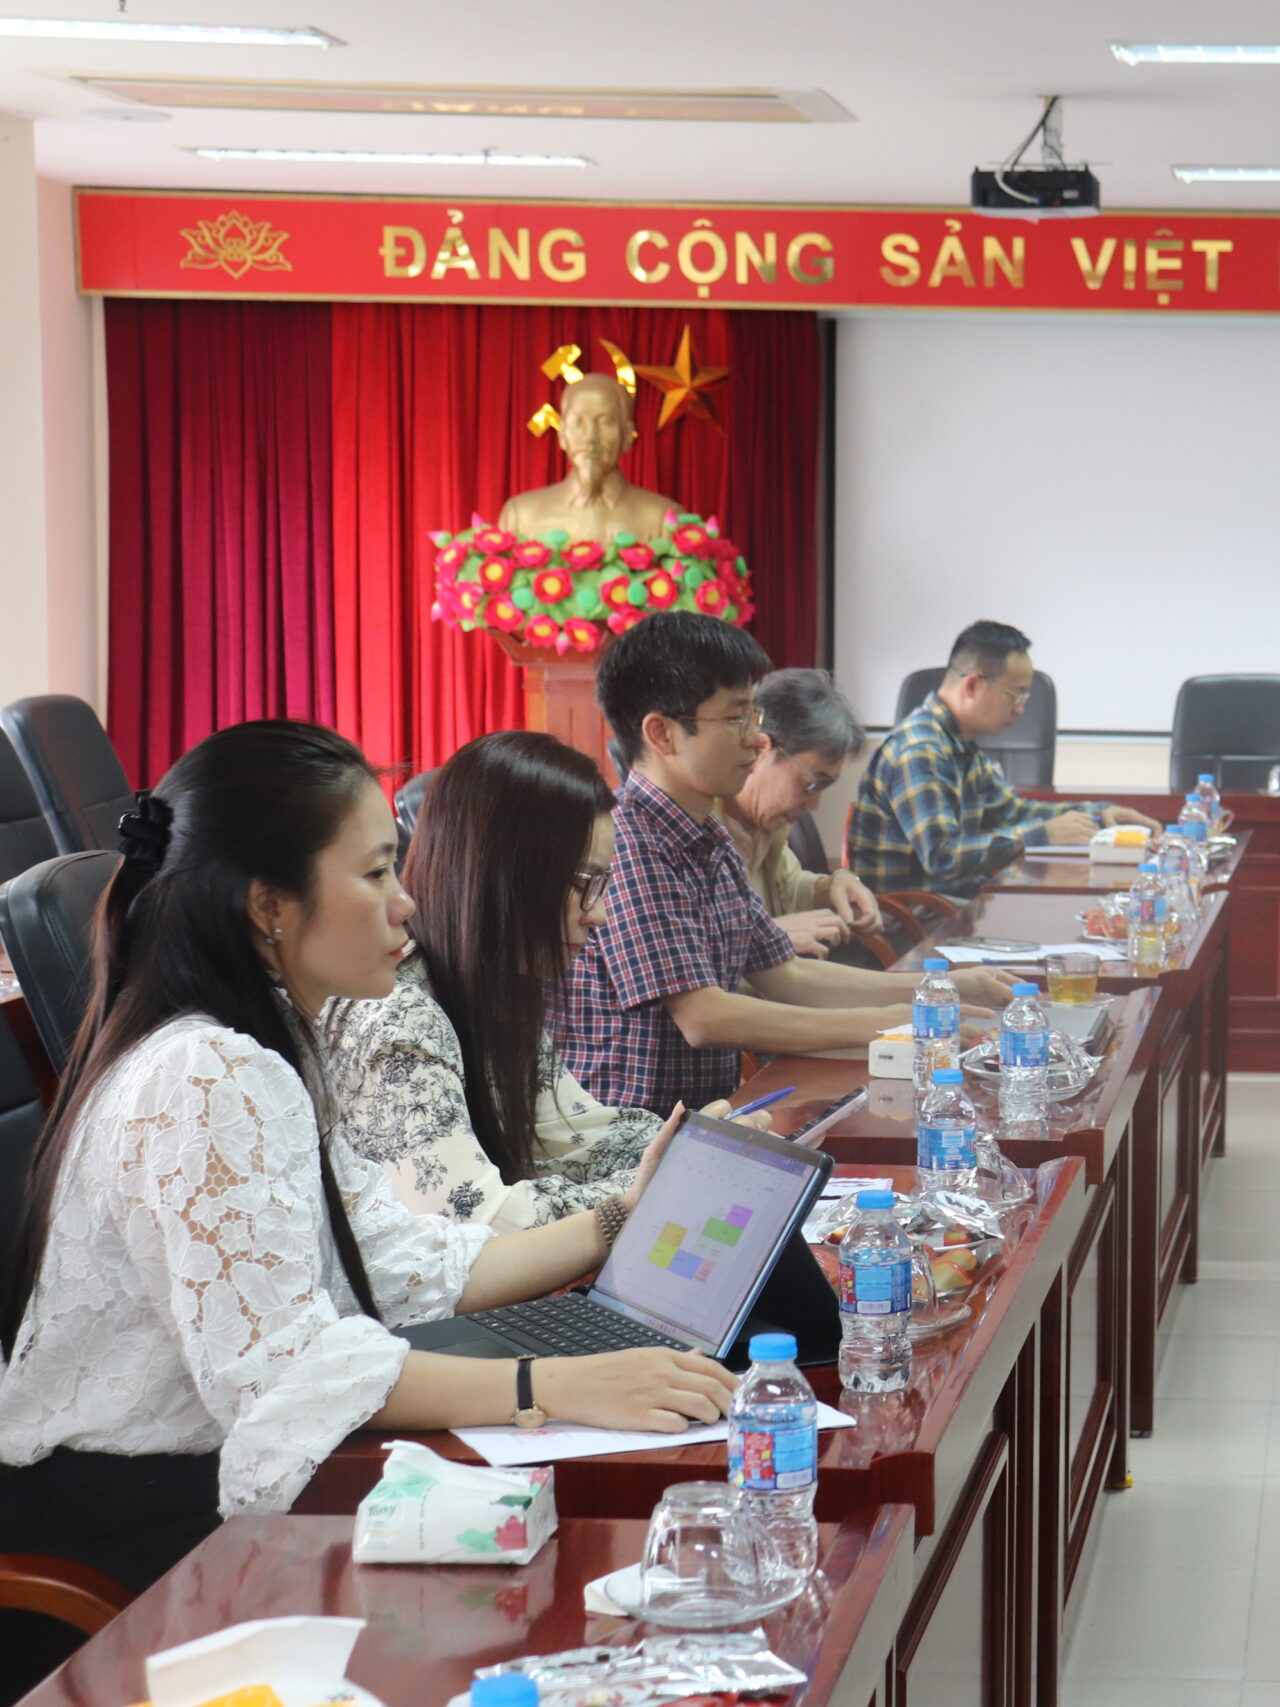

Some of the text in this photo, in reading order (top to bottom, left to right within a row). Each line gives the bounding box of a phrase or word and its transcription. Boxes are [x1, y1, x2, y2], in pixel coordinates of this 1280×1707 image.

[378, 208, 588, 284] ĐẢNG
[625, 217, 835, 299] CỘNG
[879, 217, 1026, 290] SẢN
[1069, 224, 1234, 307] VIỆT
